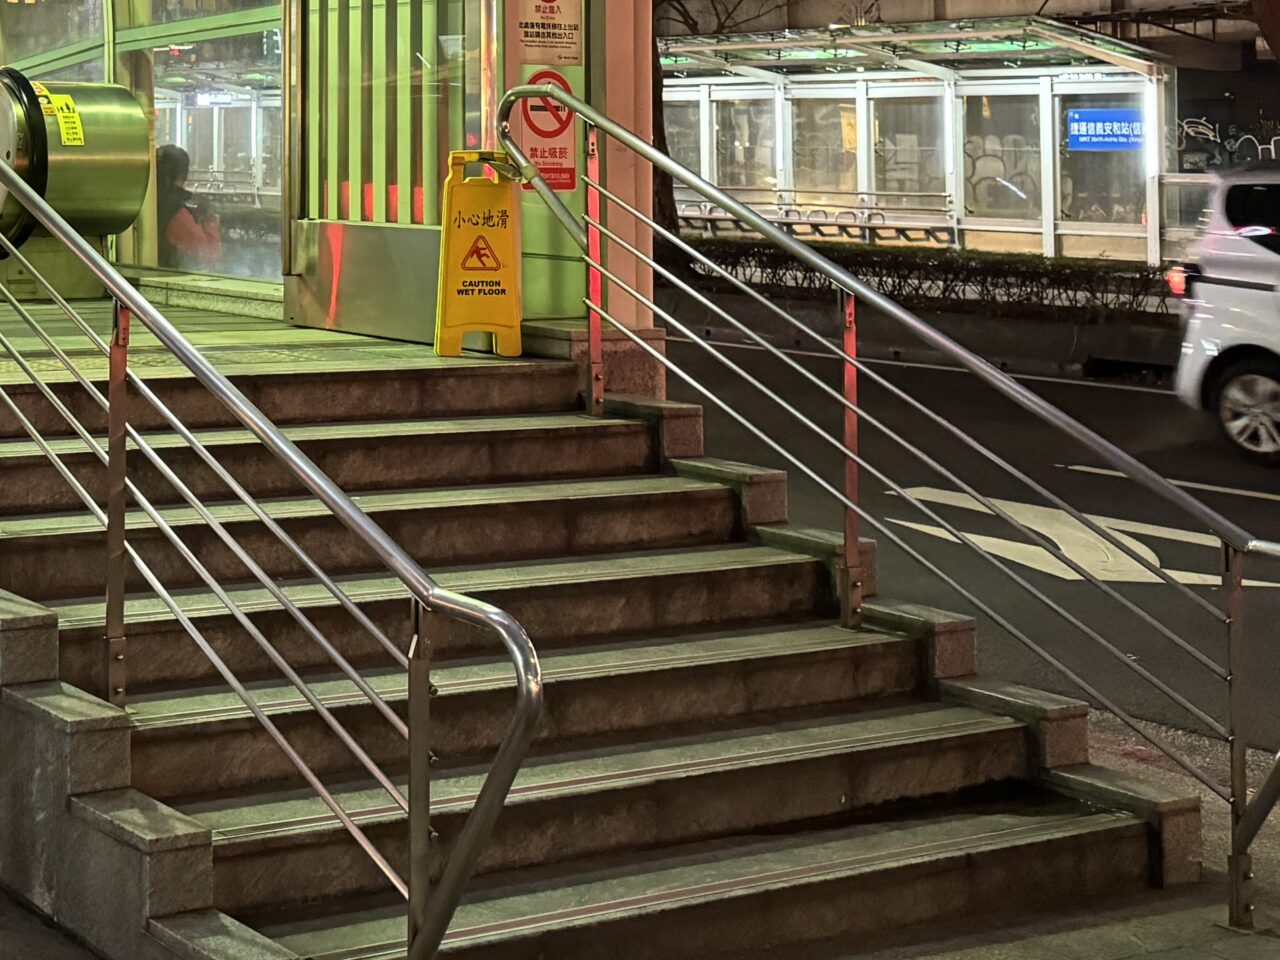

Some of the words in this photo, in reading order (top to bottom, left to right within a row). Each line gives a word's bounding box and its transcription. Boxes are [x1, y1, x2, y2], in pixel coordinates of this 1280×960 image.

[529, 146, 568, 159] 禁止吸菸
[453, 209, 509, 229] 小心地滑
[462, 280, 501, 288] CAUTION
